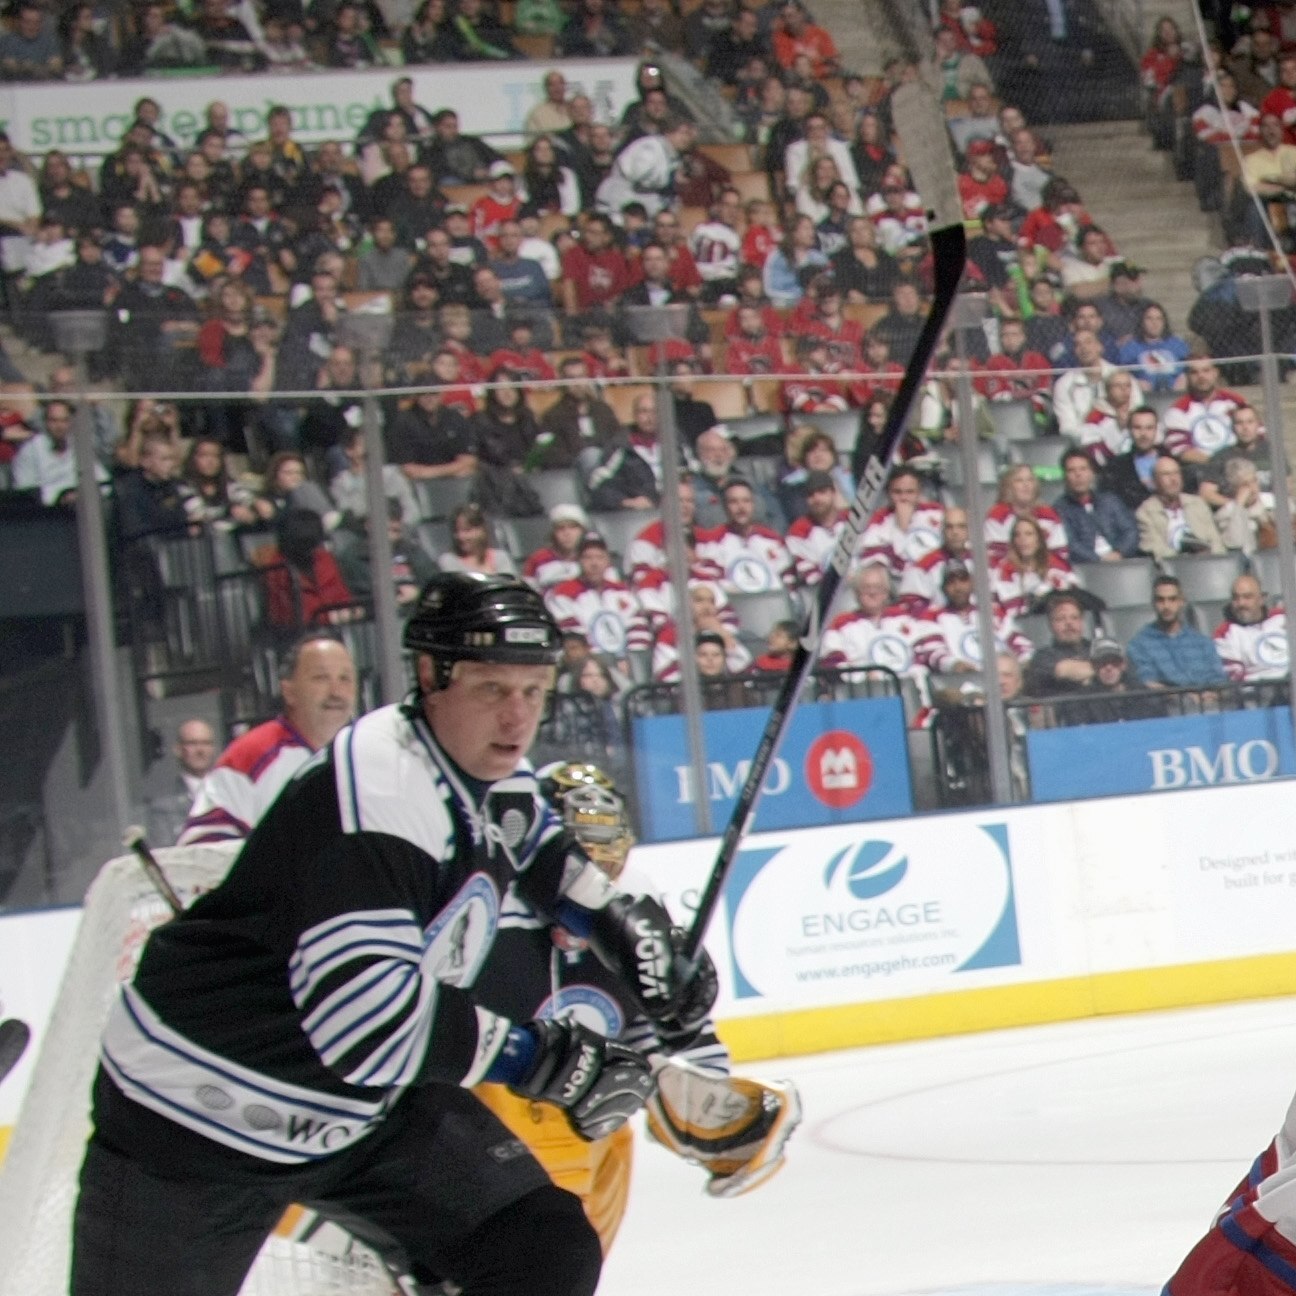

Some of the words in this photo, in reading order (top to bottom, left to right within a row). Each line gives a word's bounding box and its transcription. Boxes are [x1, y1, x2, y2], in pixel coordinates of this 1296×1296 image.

[1147, 738, 1280, 790] BMO
[1199, 847, 1271, 872] Designed
[1224, 872, 1261, 890] built
[1263, 869, 1285, 886] for
[802, 901, 943, 939] ENGAGE
[794, 951, 957, 983] www.engagehr.com
